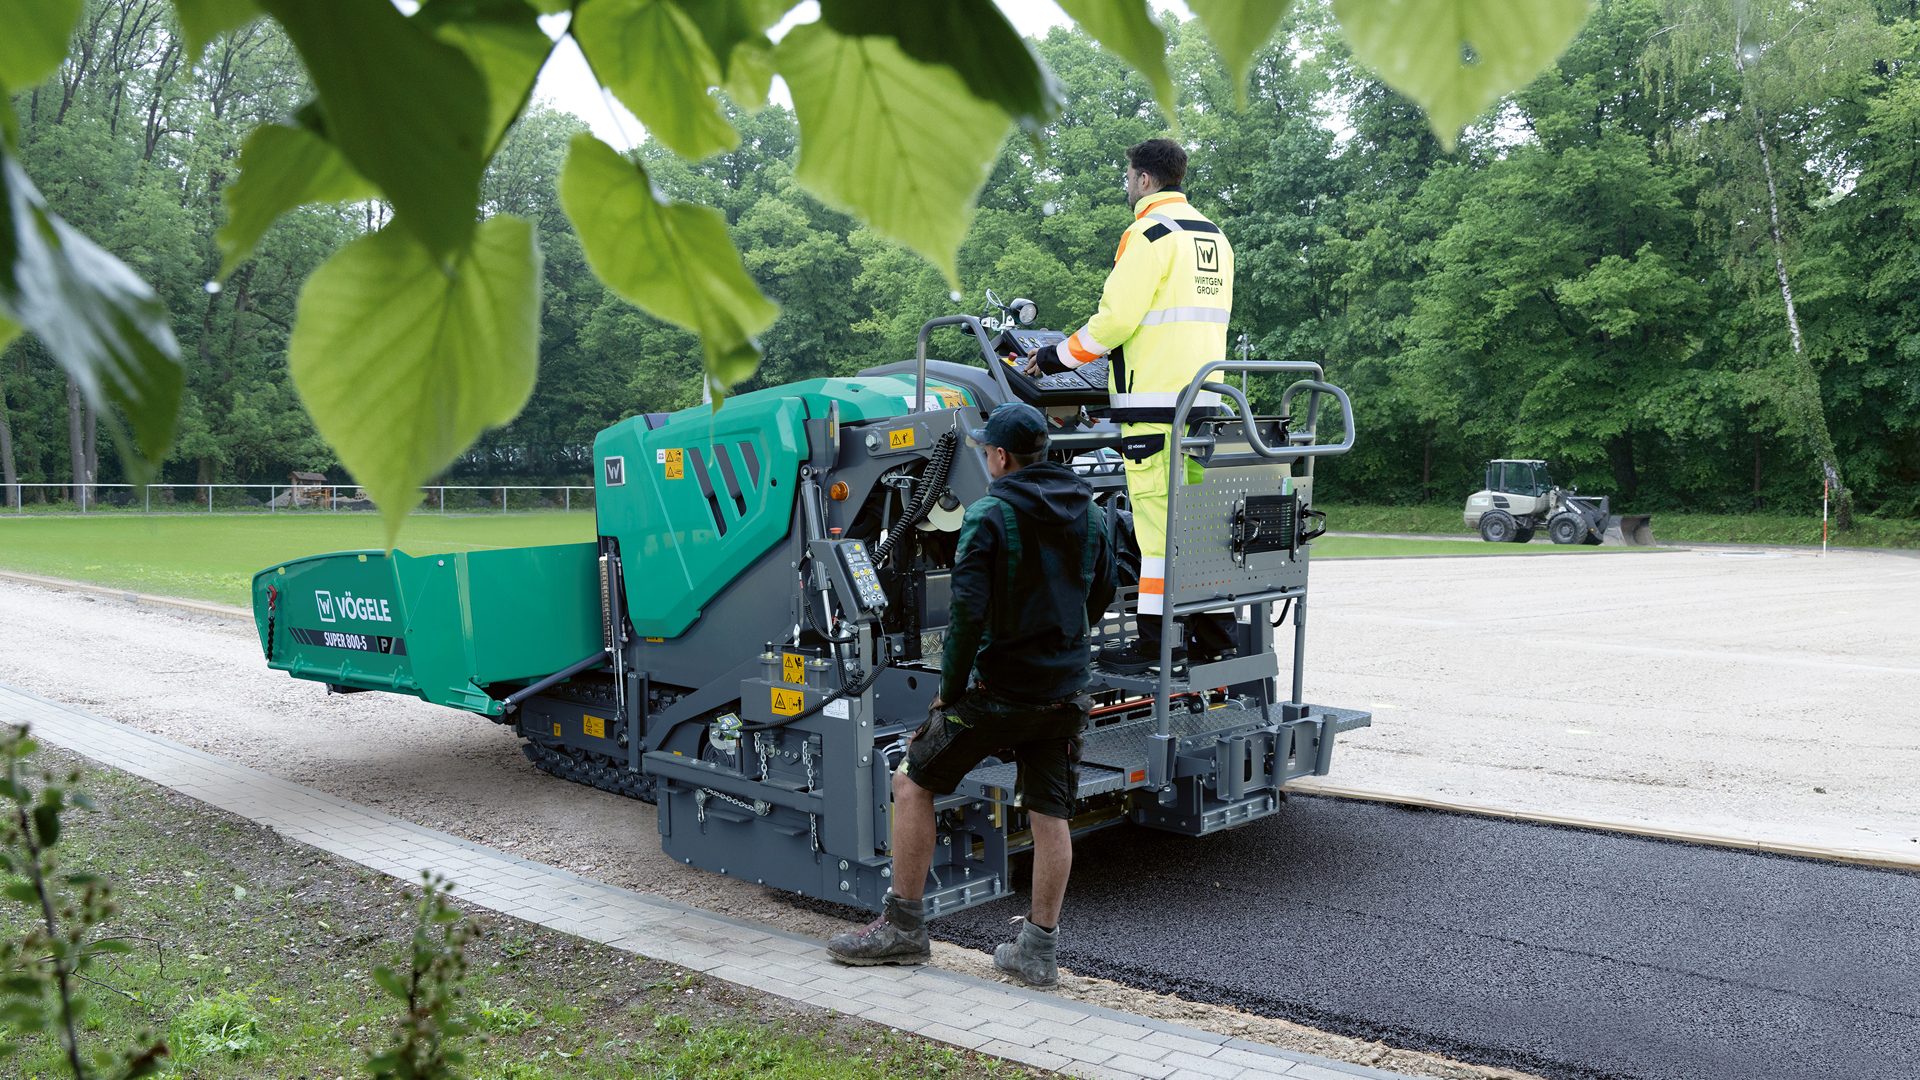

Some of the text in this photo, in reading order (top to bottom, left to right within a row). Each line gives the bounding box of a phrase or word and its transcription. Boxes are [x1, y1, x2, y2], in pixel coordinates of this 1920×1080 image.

[1194, 276, 1223, 286] WIRTGEN
[1196, 285, 1219, 295] GROUP
[335, 591, 392, 622] VÖGELE
[324, 631, 347, 648] SUPER
[380, 638, 388, 652] P
